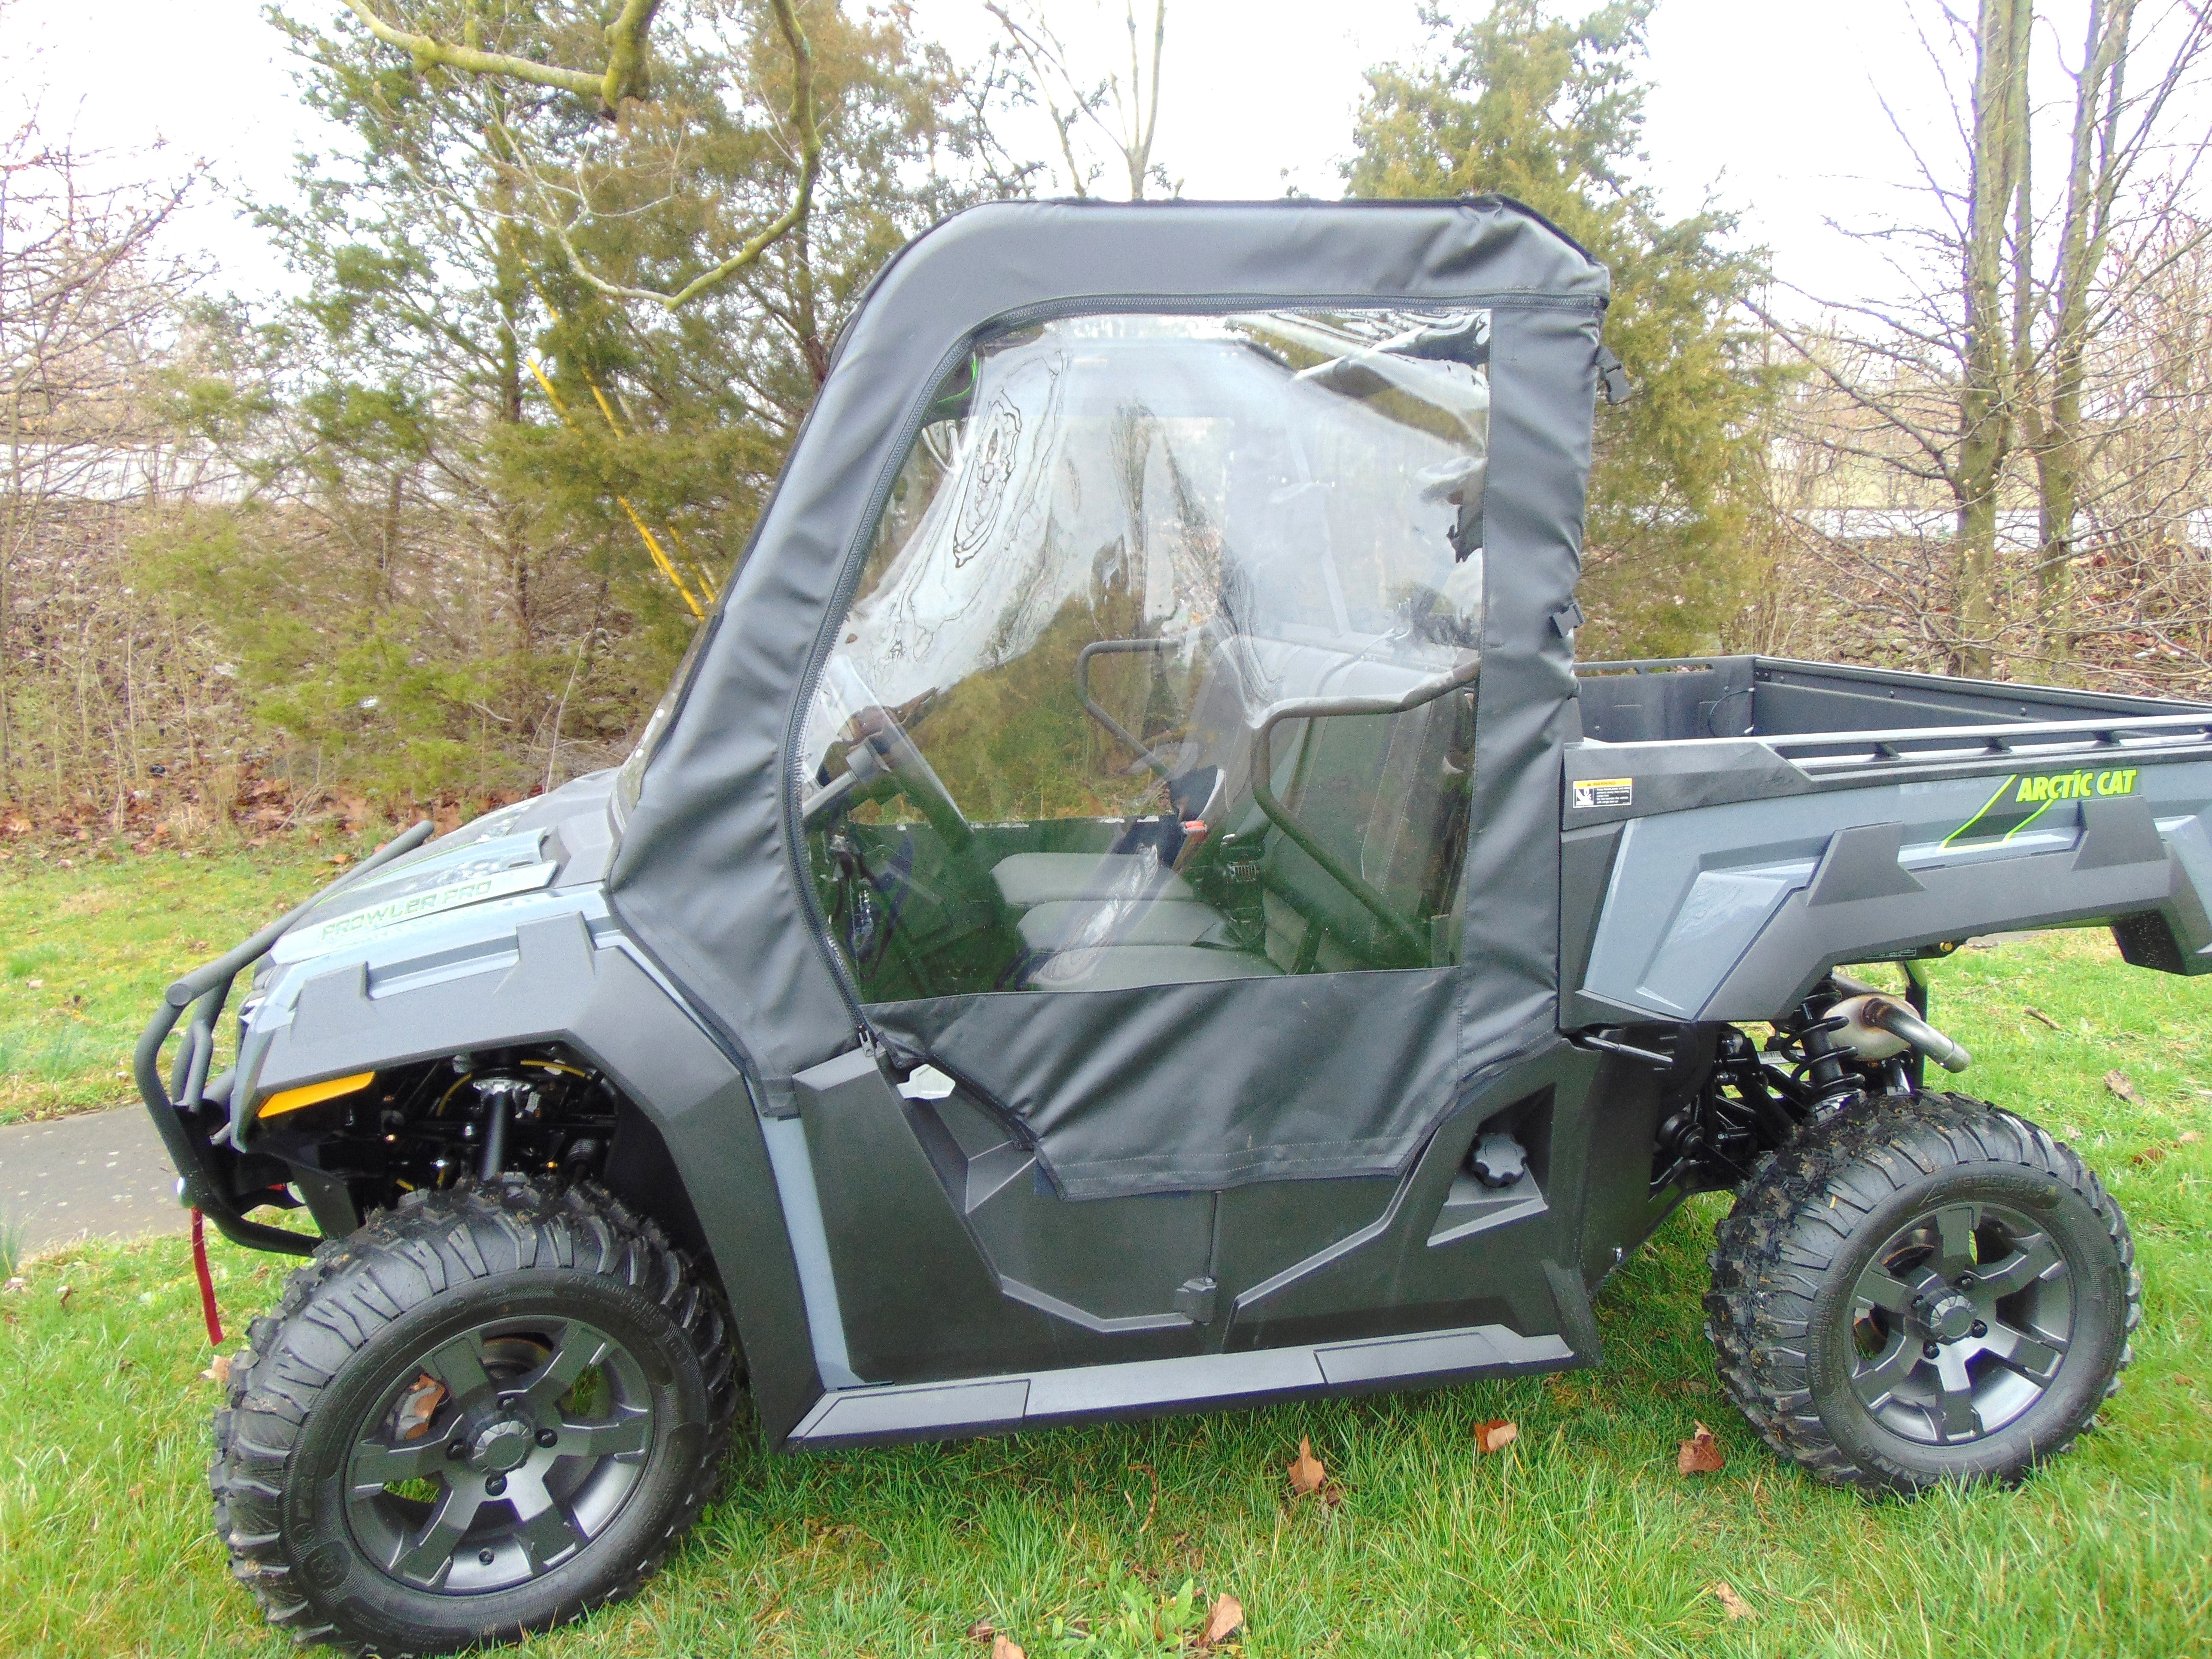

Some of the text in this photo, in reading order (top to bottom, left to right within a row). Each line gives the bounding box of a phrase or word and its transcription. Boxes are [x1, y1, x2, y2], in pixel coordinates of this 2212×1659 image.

[2015, 769, 2137, 802] ARCTIC CAT
[322, 880, 492, 939] PROWLER PRO
